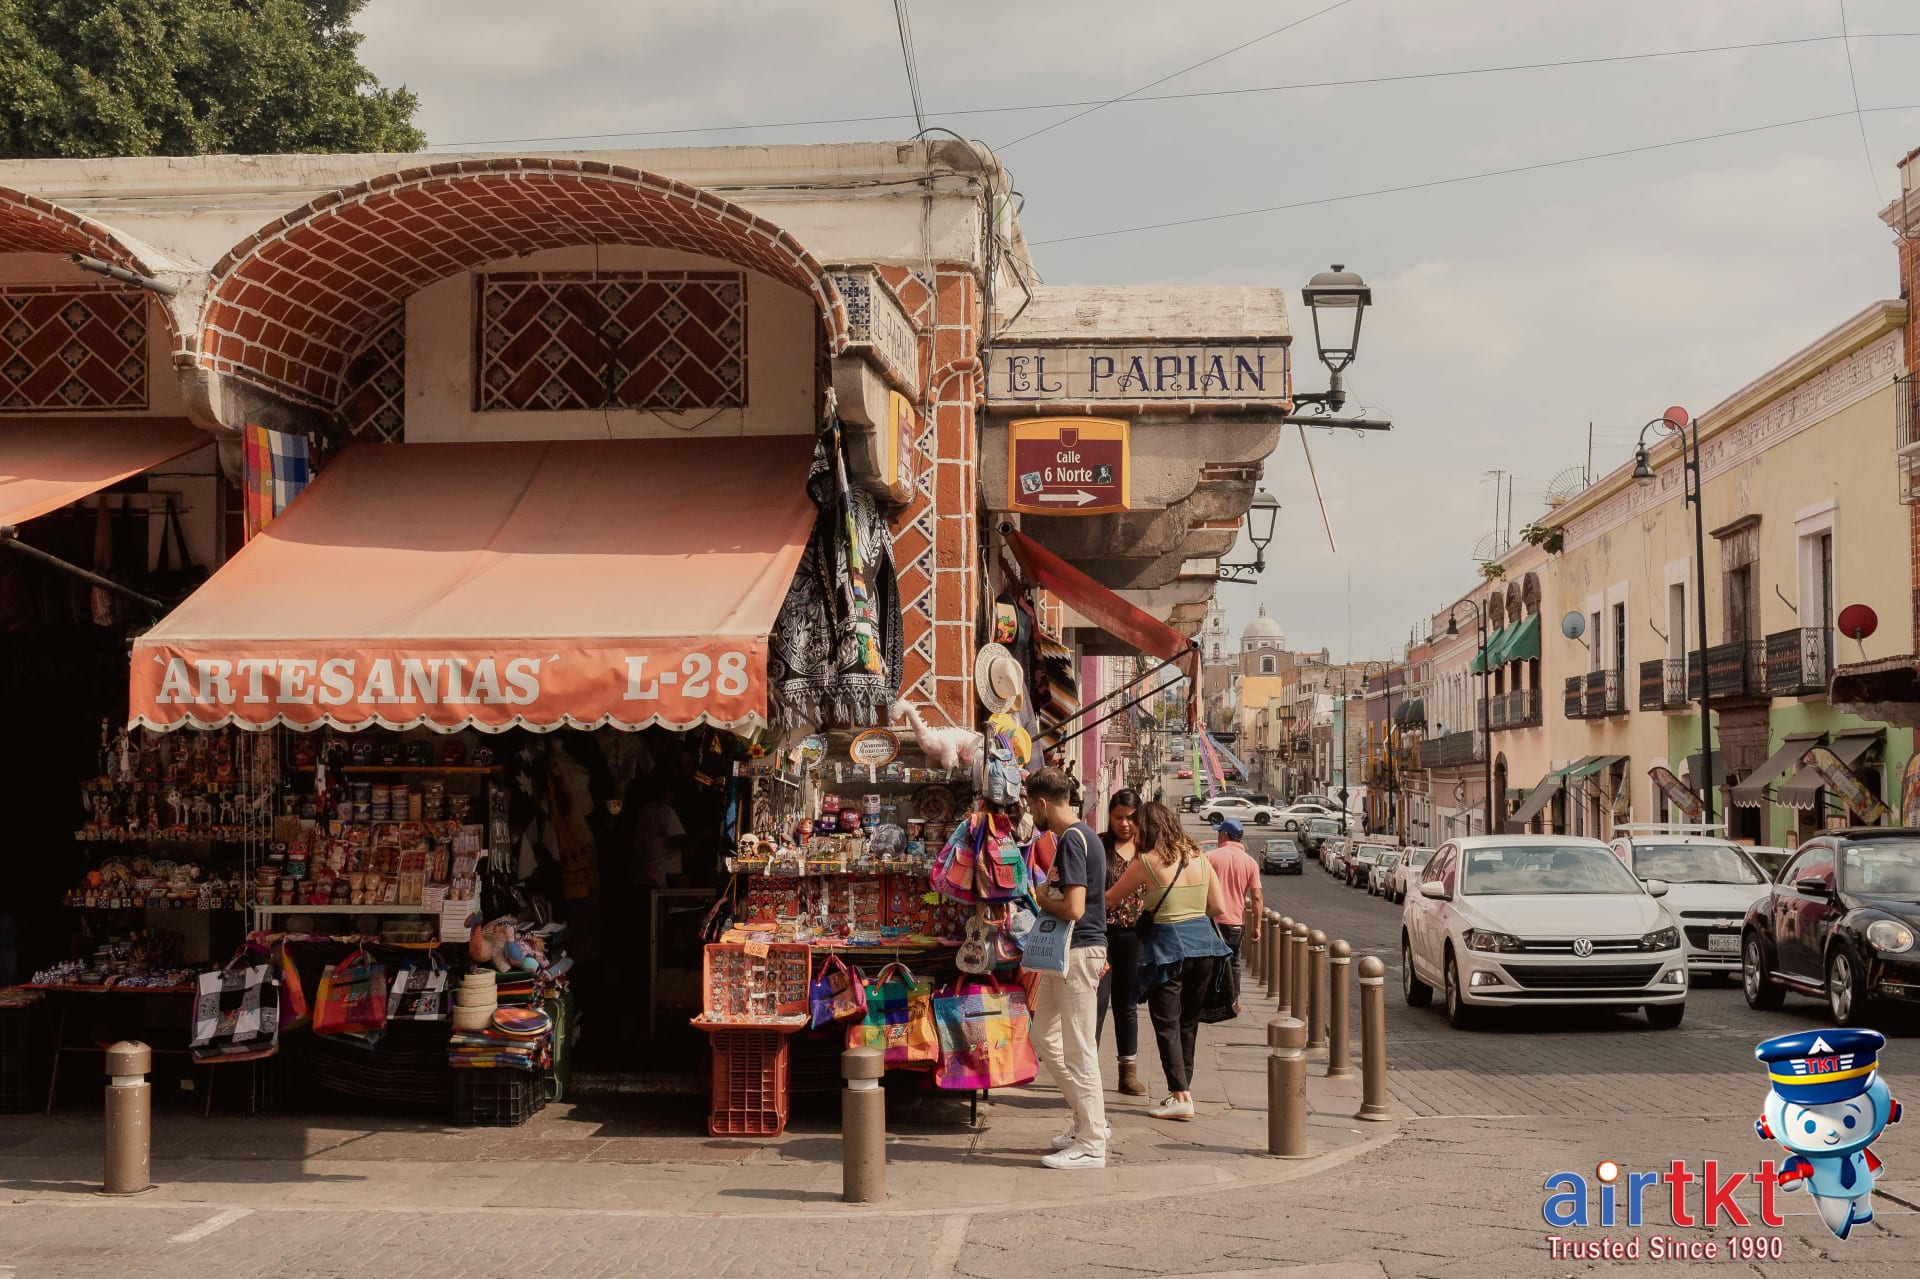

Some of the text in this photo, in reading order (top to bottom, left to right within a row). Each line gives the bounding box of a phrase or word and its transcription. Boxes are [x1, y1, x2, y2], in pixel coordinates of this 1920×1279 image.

[1006, 354, 1267, 394] EL PARIAN
[1056, 450, 1081, 464] Calle
[1044, 466, 1093, 482] 6 Norte
[622, 651, 749, 701] L-28
